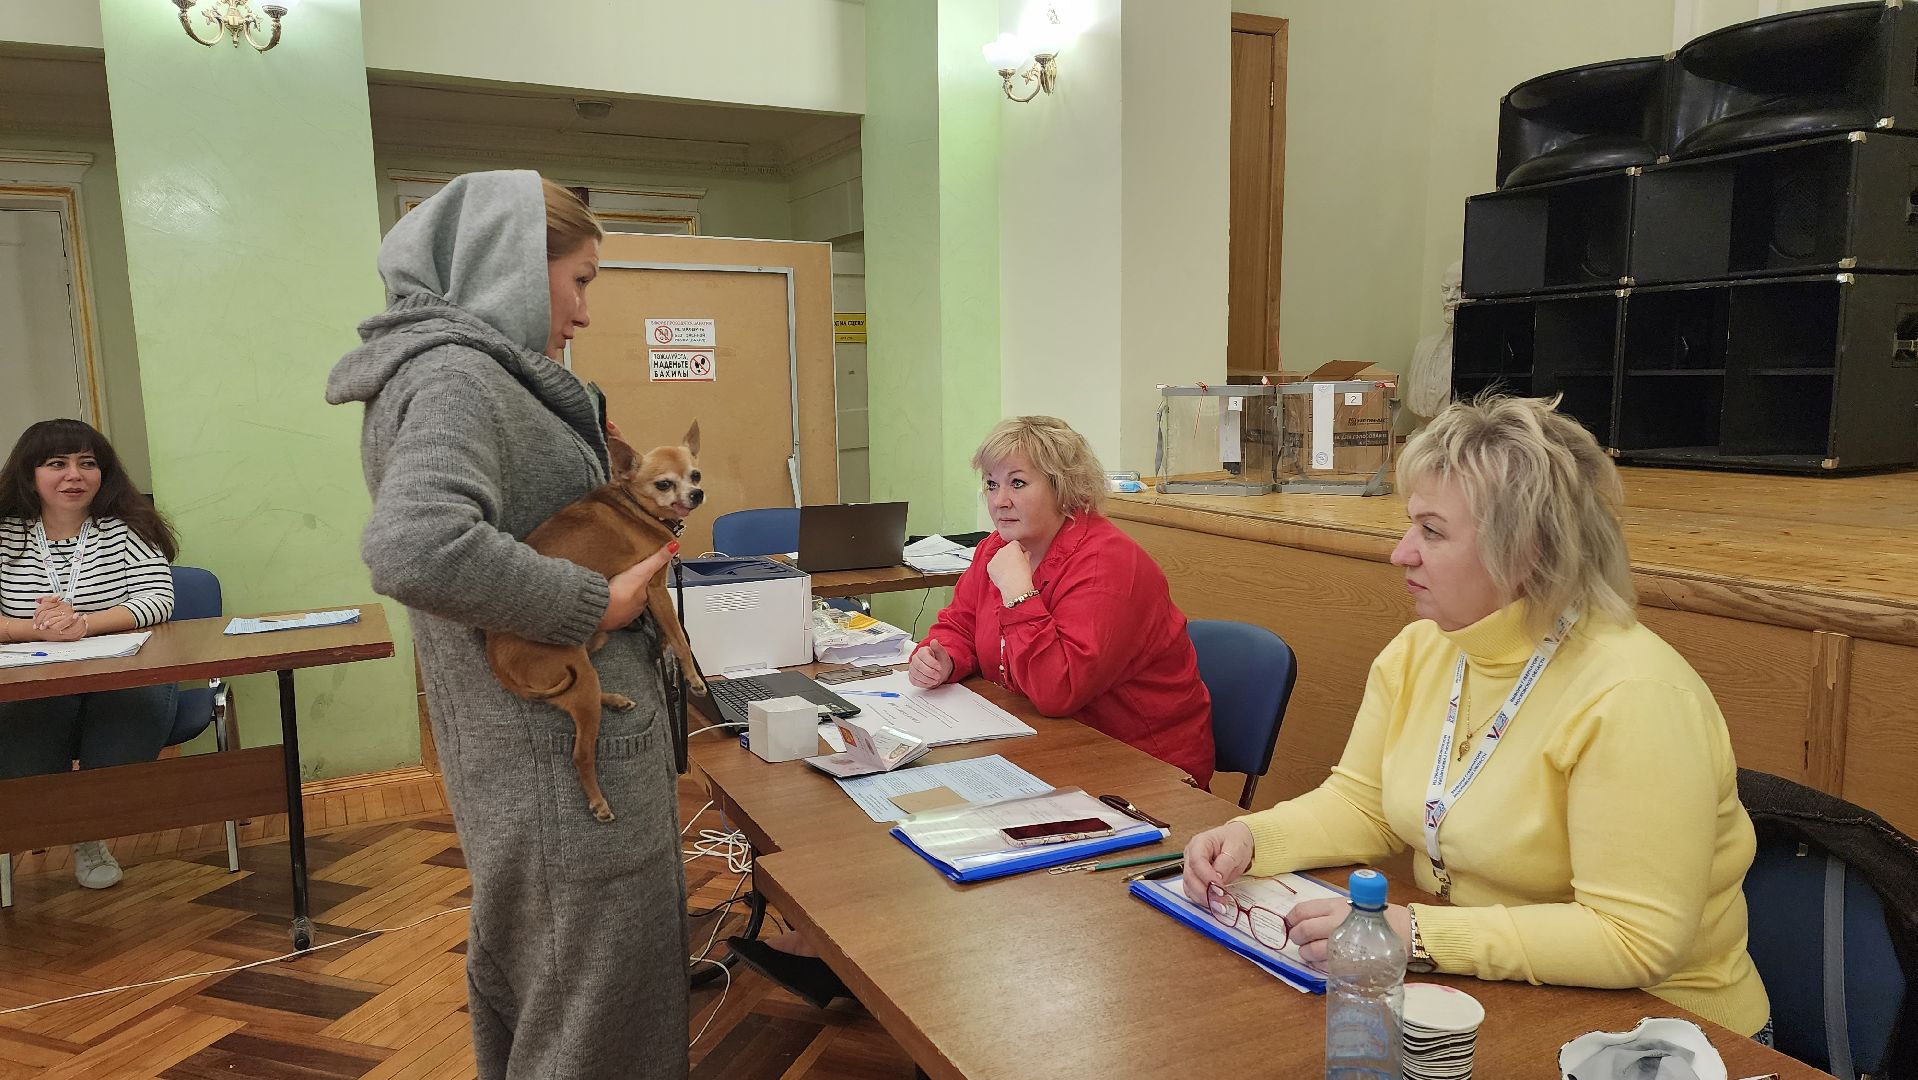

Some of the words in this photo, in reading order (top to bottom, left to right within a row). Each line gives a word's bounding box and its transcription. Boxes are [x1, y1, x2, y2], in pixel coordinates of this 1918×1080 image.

[653, 361, 689, 369] НАДЕНЬТЕ
[654, 370, 689, 378] БАХИЛЫ
[1350, 395, 1357, 404] 2
